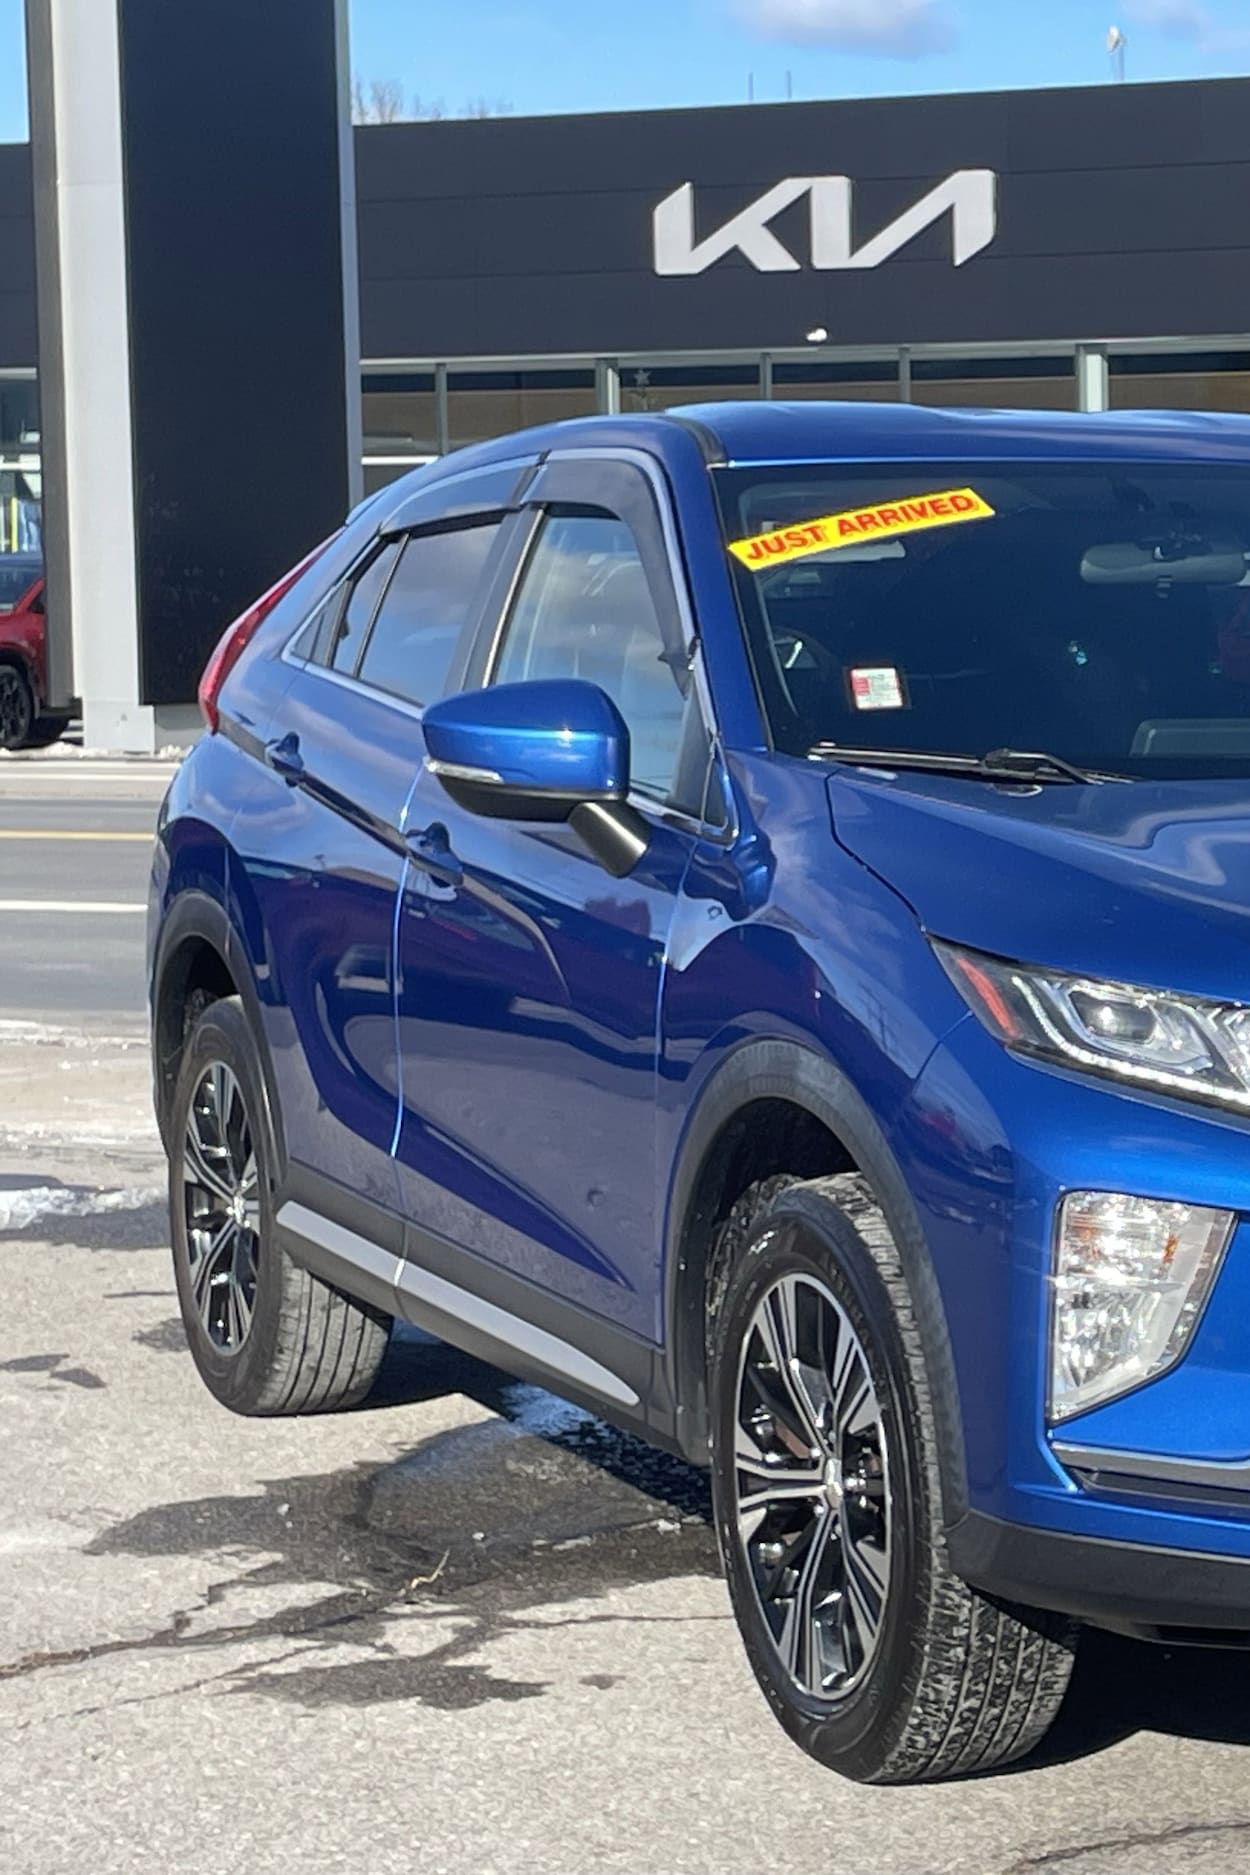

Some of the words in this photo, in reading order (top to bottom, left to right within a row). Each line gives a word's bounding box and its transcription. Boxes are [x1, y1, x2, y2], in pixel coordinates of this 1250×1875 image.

[654, 169, 997, 275] KIA
[746, 526, 824, 561] JUST
[836, 494, 975, 537] ARRIVED
